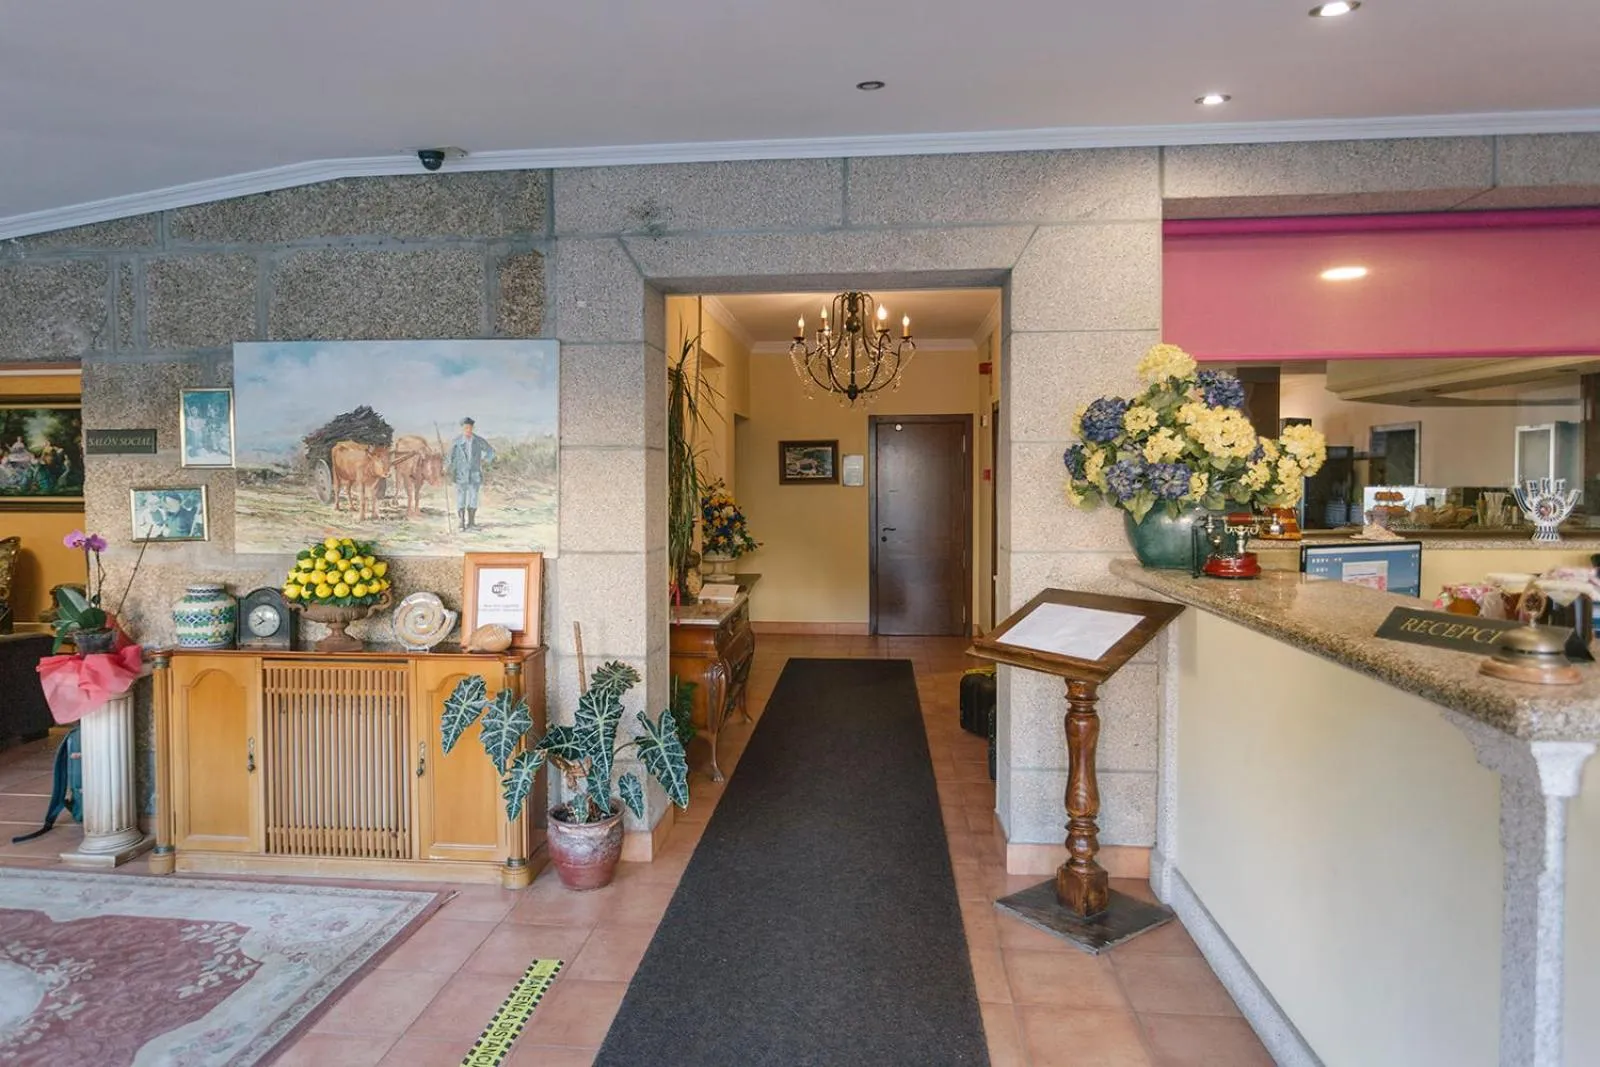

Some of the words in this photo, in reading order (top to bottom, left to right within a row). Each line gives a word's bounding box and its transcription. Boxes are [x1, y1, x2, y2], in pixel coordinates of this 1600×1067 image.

[87, 435, 118, 447] SALÓN
[120, 436, 151, 446] SOCIAL
[1400, 617, 1503, 645] RECEPCI
